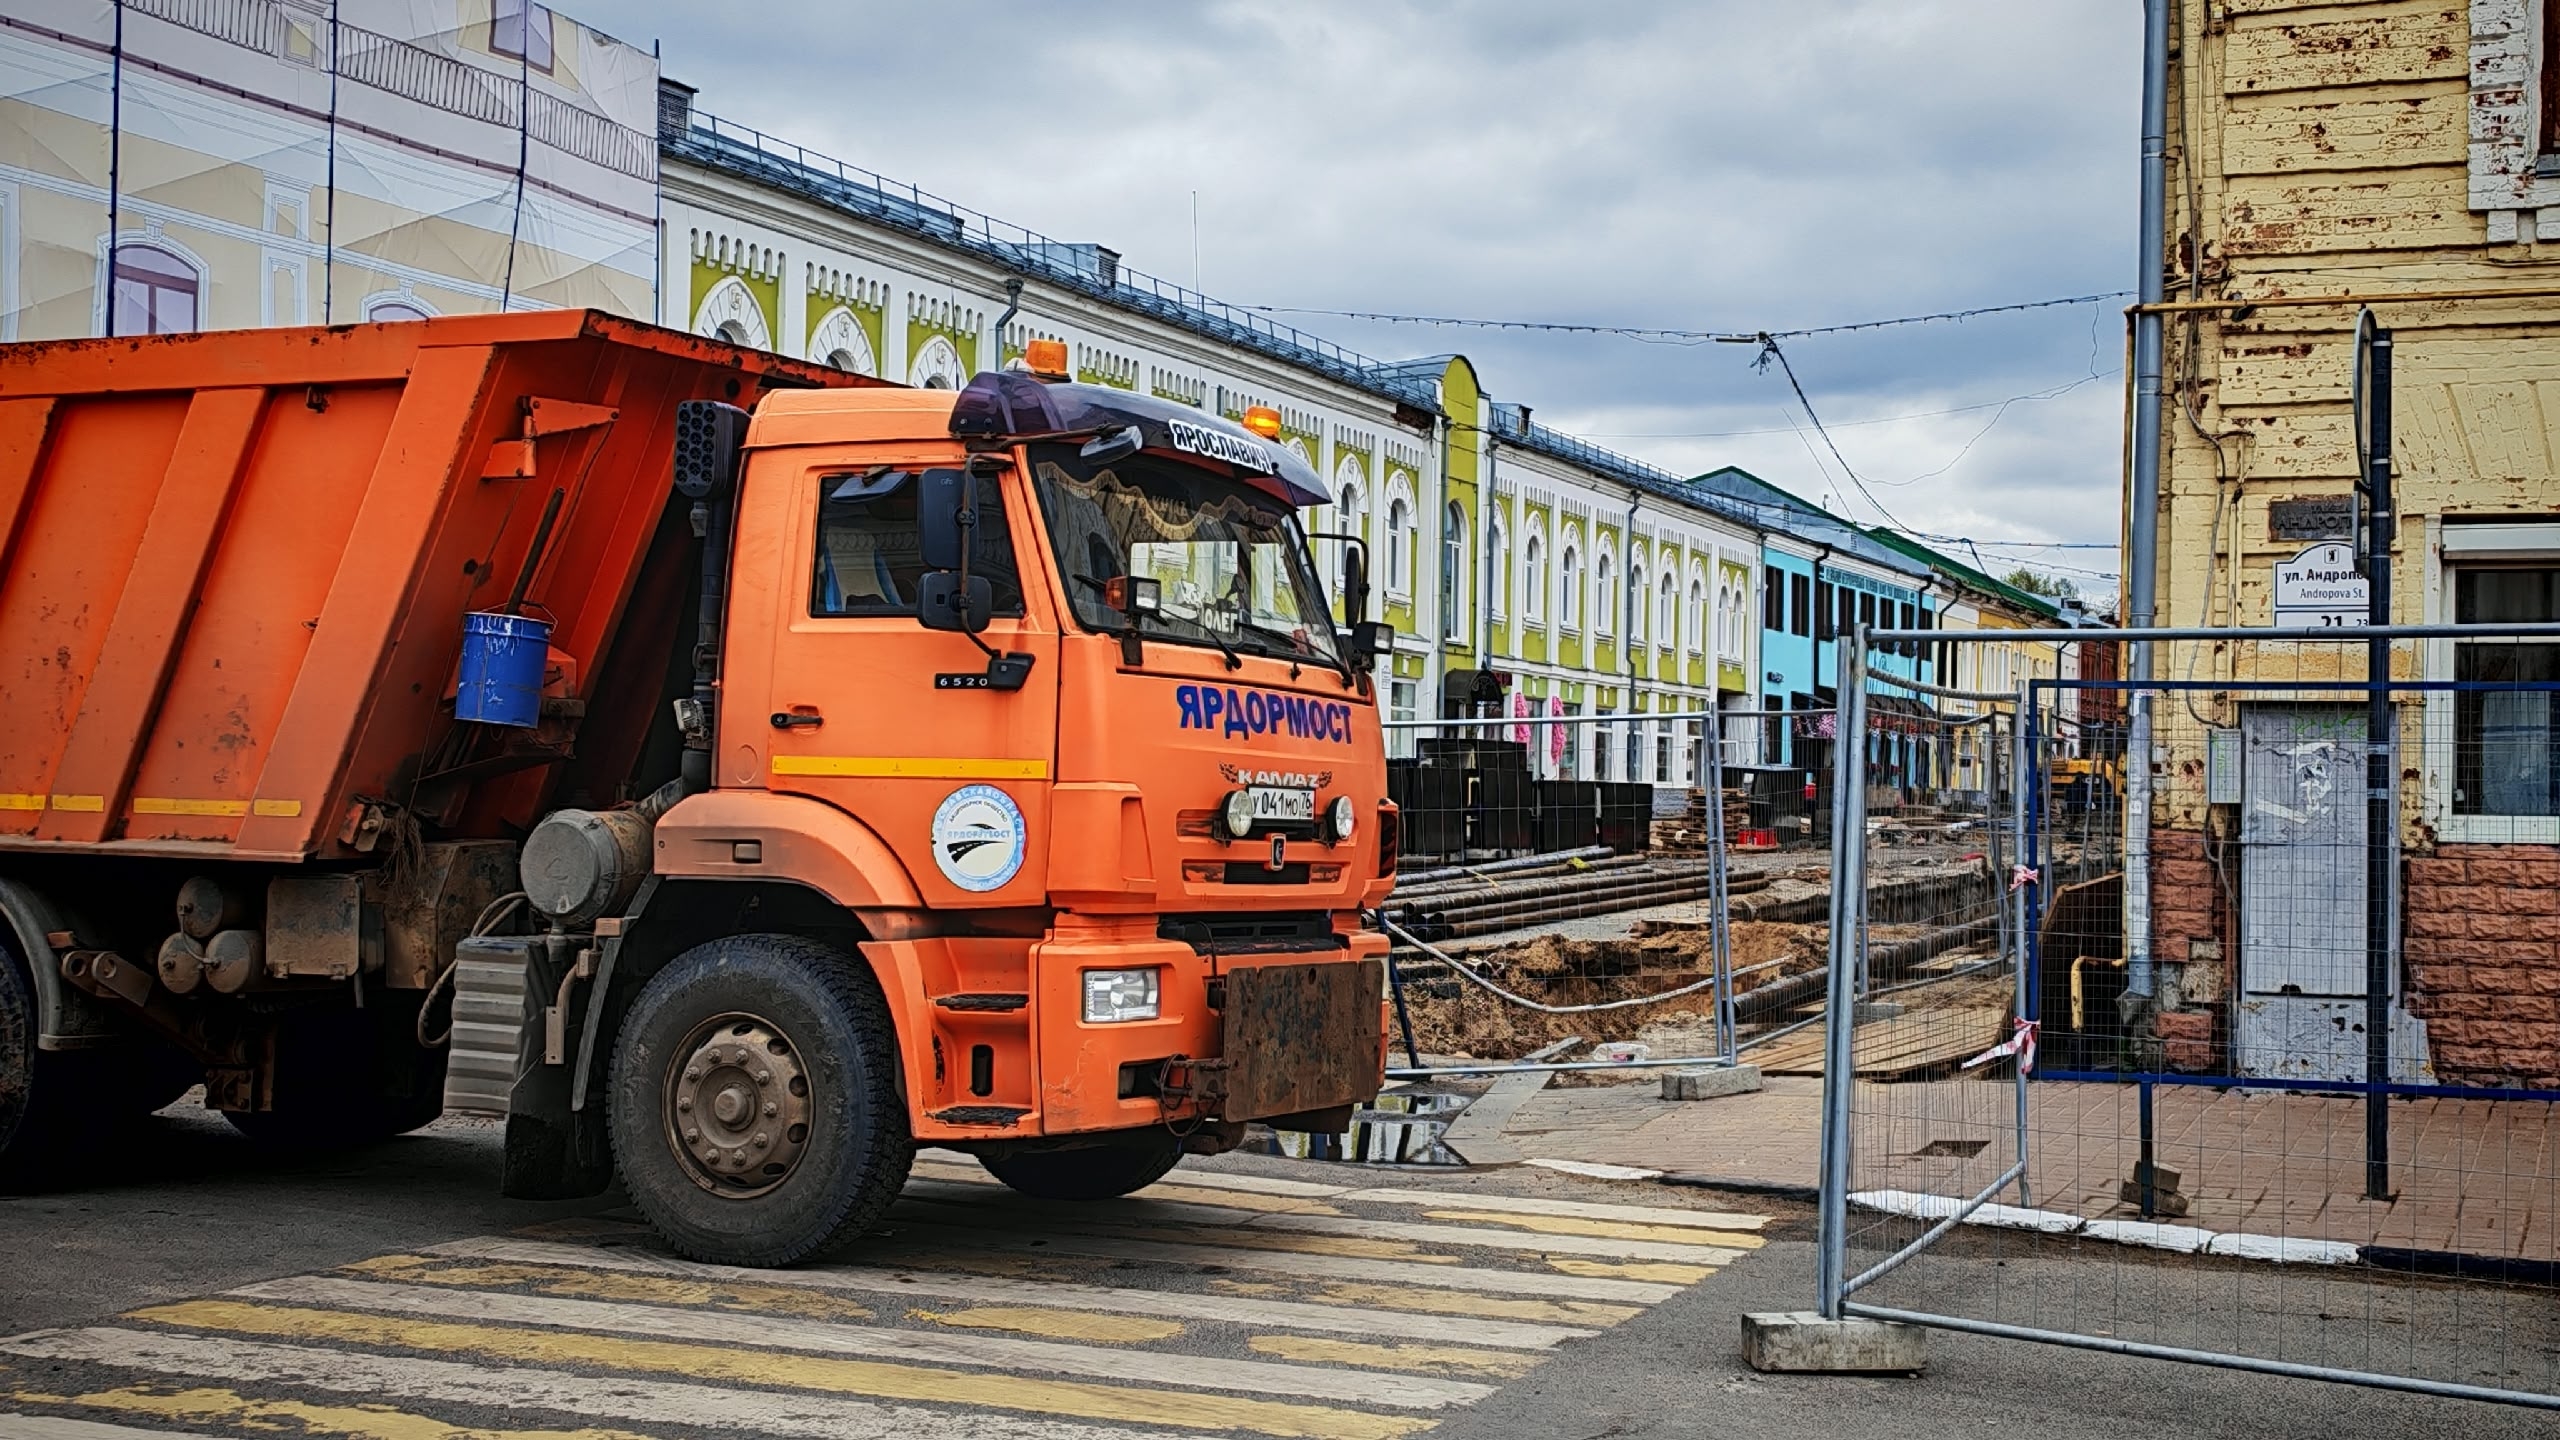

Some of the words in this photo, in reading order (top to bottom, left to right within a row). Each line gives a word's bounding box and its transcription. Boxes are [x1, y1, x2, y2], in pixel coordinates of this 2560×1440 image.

[1171, 422, 1273, 474] ЯРОСЛАВИЧ
[2284, 571, 2304, 585] ул.
[2299, 587, 2351, 601] Andropova
[2353, 587, 2366, 599] St.
[2321, 615, 2343, 627] 21
[939, 676, 989, 688] 6520
[1176, 684, 1353, 745] ЯРДОРМОСТ
[1301, 792, 1312, 810] 76
